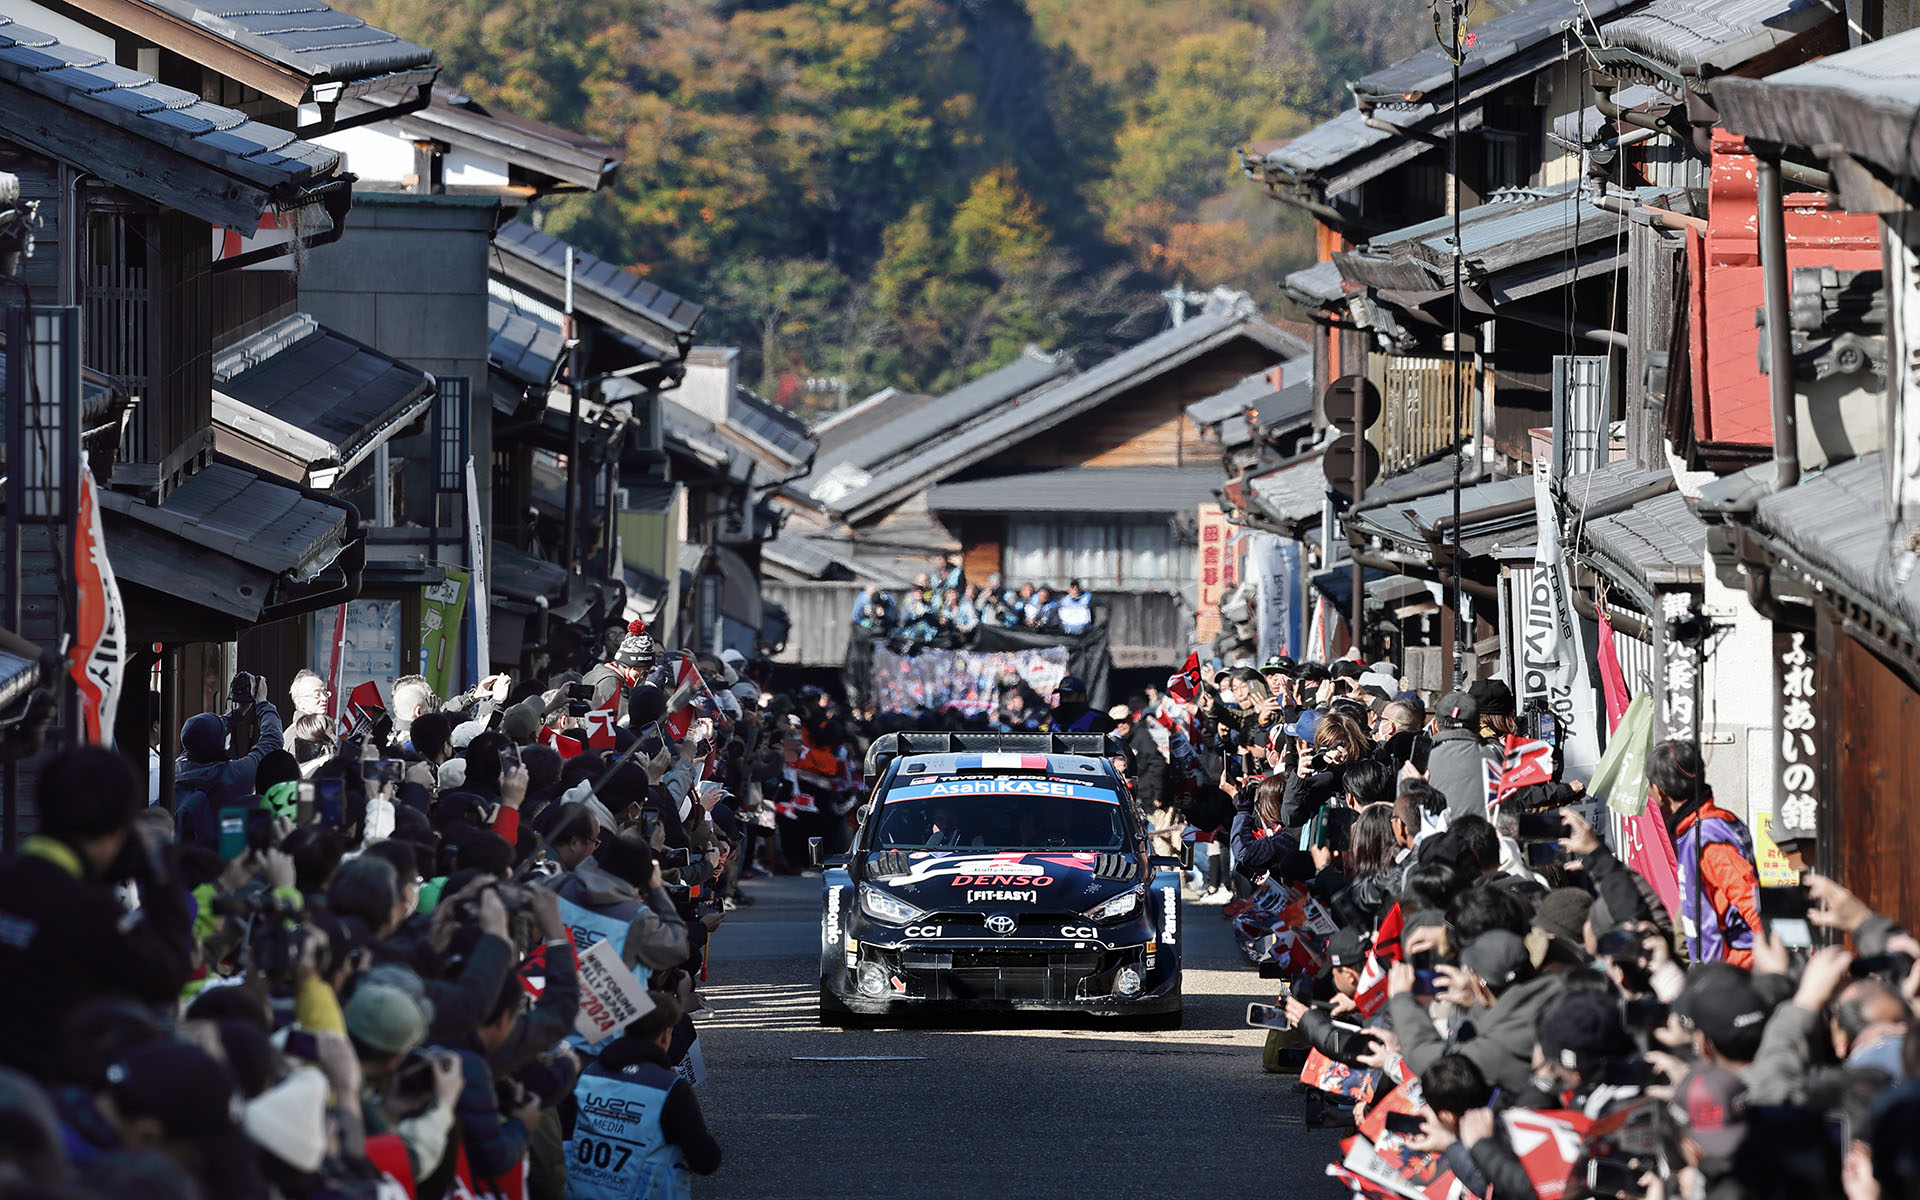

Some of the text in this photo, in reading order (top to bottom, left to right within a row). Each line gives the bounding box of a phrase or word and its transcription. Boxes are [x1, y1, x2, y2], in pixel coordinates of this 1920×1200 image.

[1781, 632, 1818, 831] ふれあいの館
[1048, 777, 1095, 787] Racing
[951, 875, 1054, 887] DENSO
[1160, 886, 1177, 945] Panasonic
[904, 925, 943, 937] CCI
[1061, 926, 1099, 939] CCI
[580, 994, 617, 1034] 2024
[585, 1092, 647, 1117] WRC
[592, 1119, 625, 1134] MEDIA
[578, 1137, 633, 1173] 007
